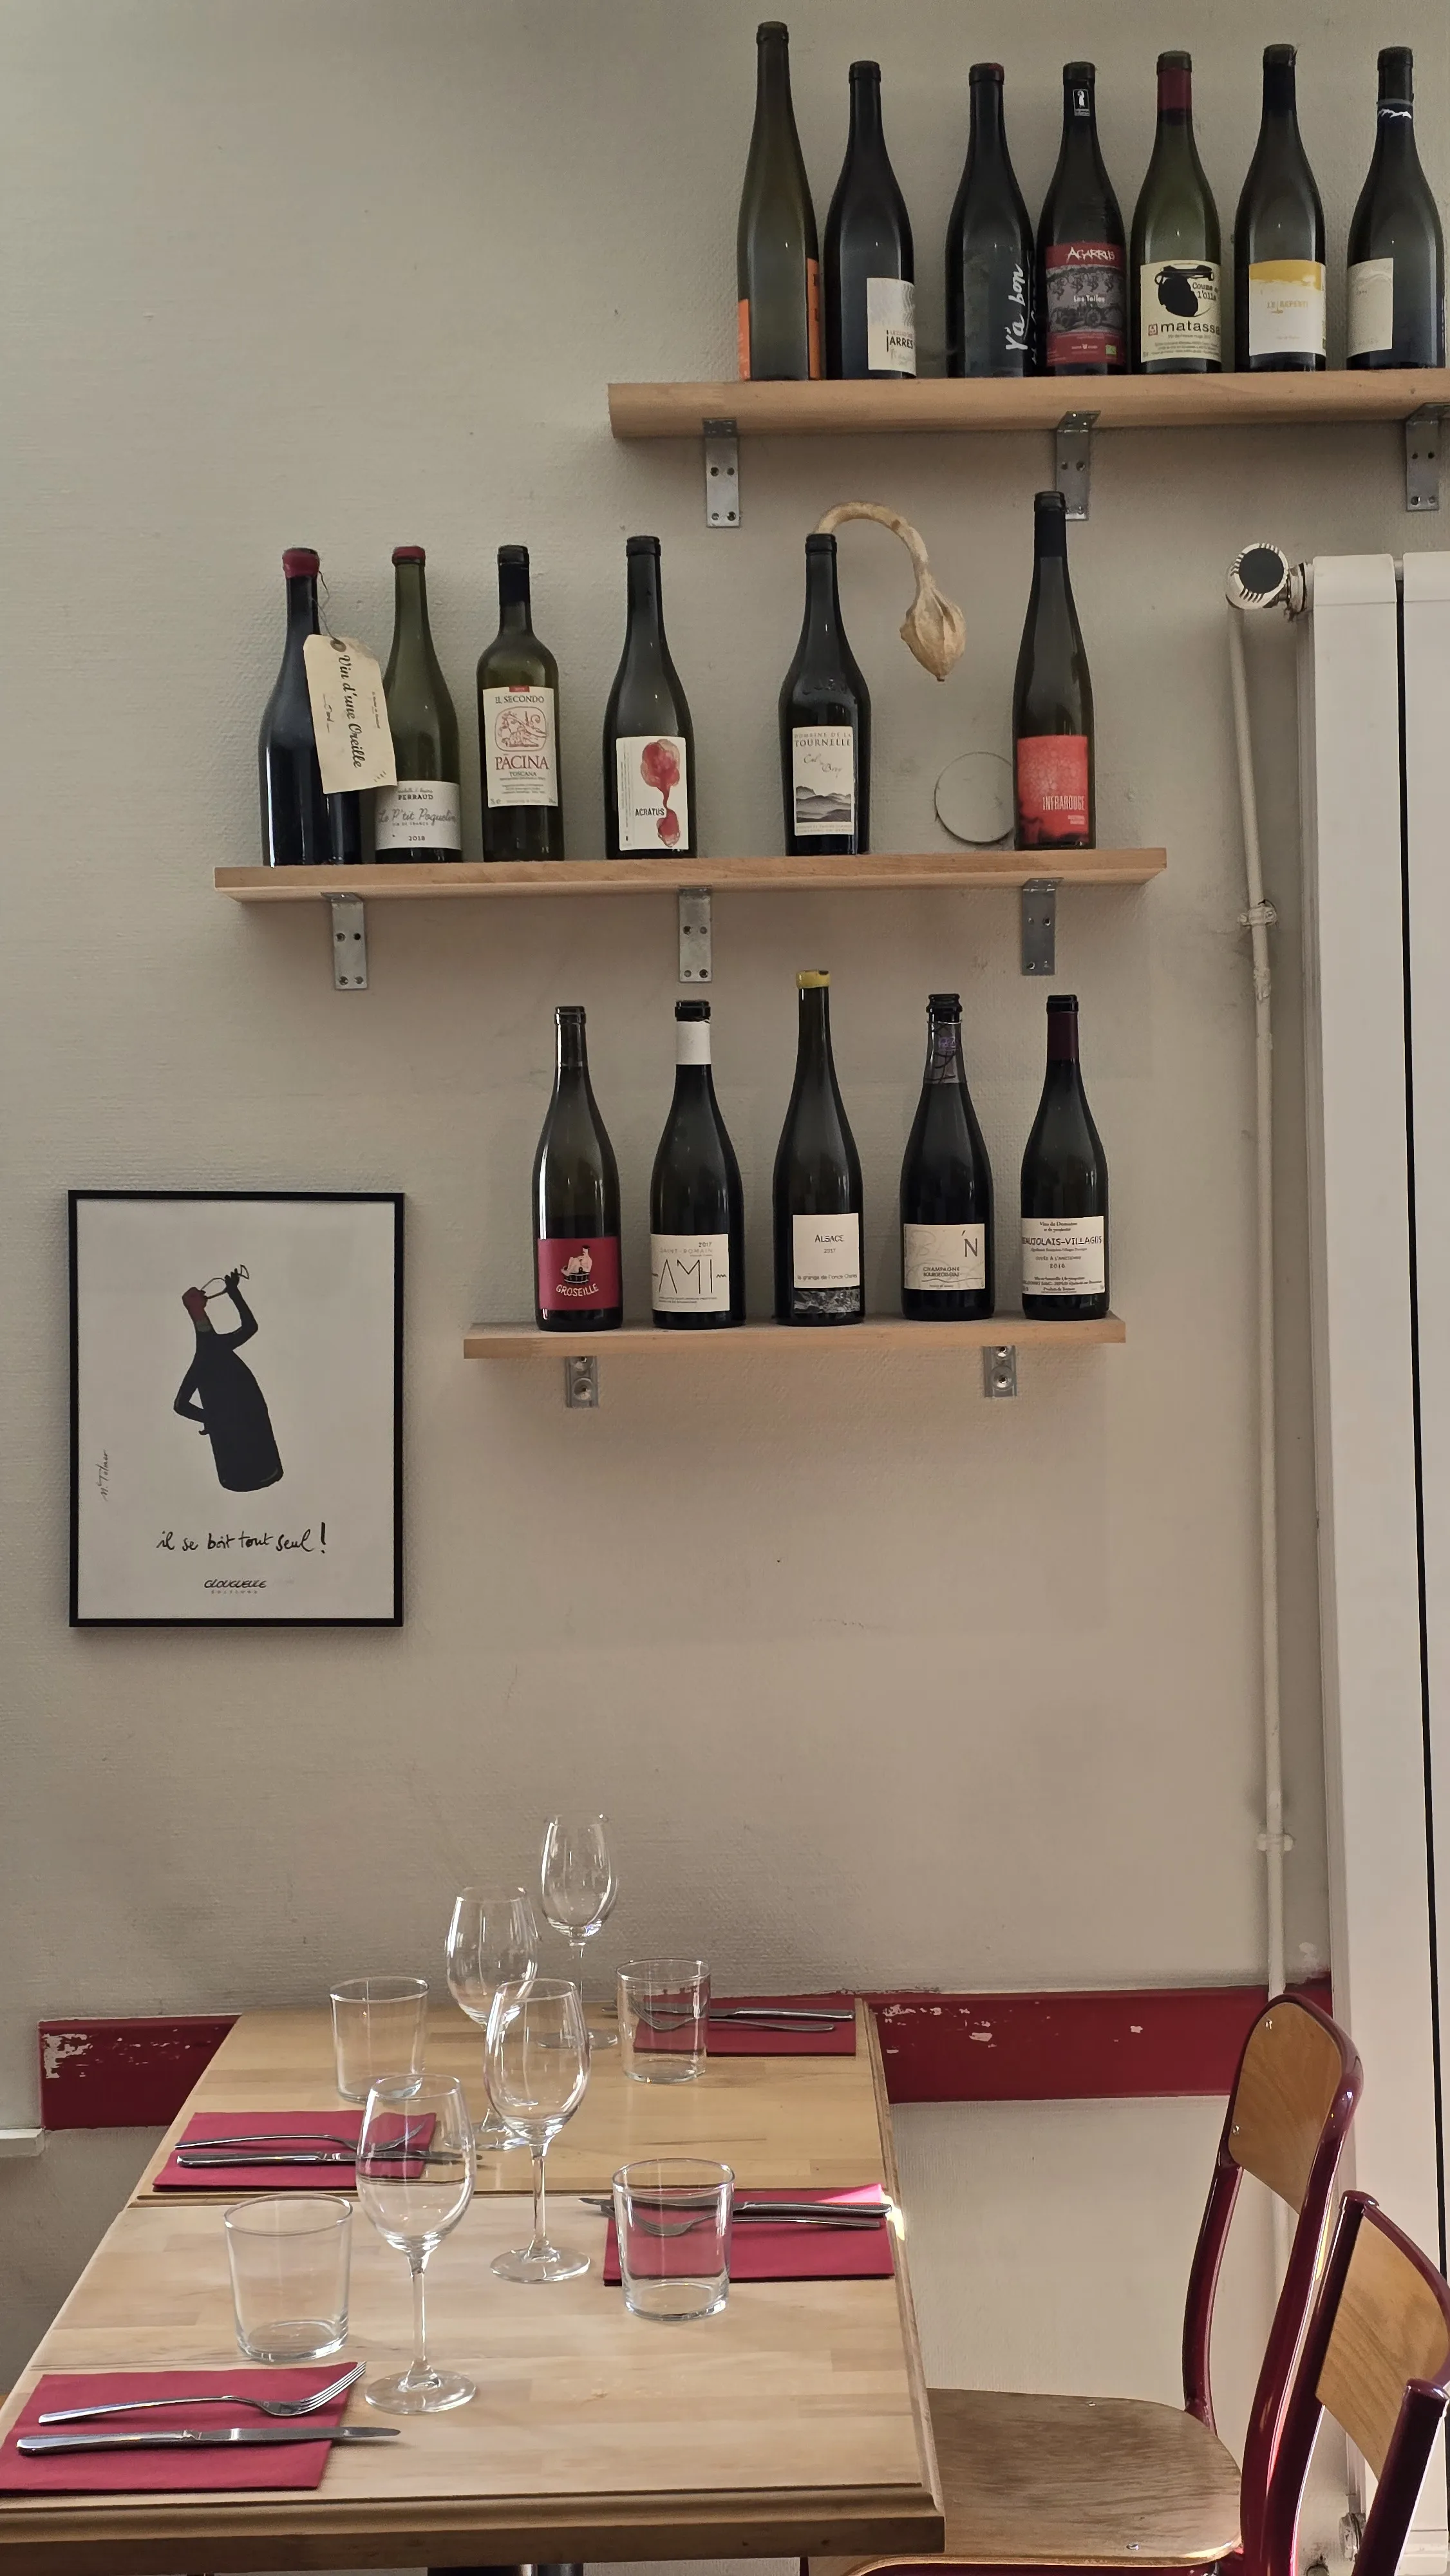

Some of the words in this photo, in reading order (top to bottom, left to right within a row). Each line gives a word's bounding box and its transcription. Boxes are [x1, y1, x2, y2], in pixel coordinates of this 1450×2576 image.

[1008, 263, 1026, 306] bon
[1161, 320, 1220, 335] matassa
[338, 654, 351, 679] Vin
[343, 682, 358, 720] d'une
[504, 695, 545, 703] SECONDO
[348, 723, 366, 768] Oreille
[795, 739, 851, 747] TOURNELLE
[1042, 795, 1086, 811] INFRAROUGE
[635, 808, 665, 817] ACRATUS
[814, 1235, 845, 1243] ALSACE
[556, 1283, 599, 1297] GROSEILLE
[156, 1530, 175, 1550] il
[182, 1537, 198, 1551] se
[207, 1532, 236, 1549] boit
[238, 1530, 274, 1548] tout
